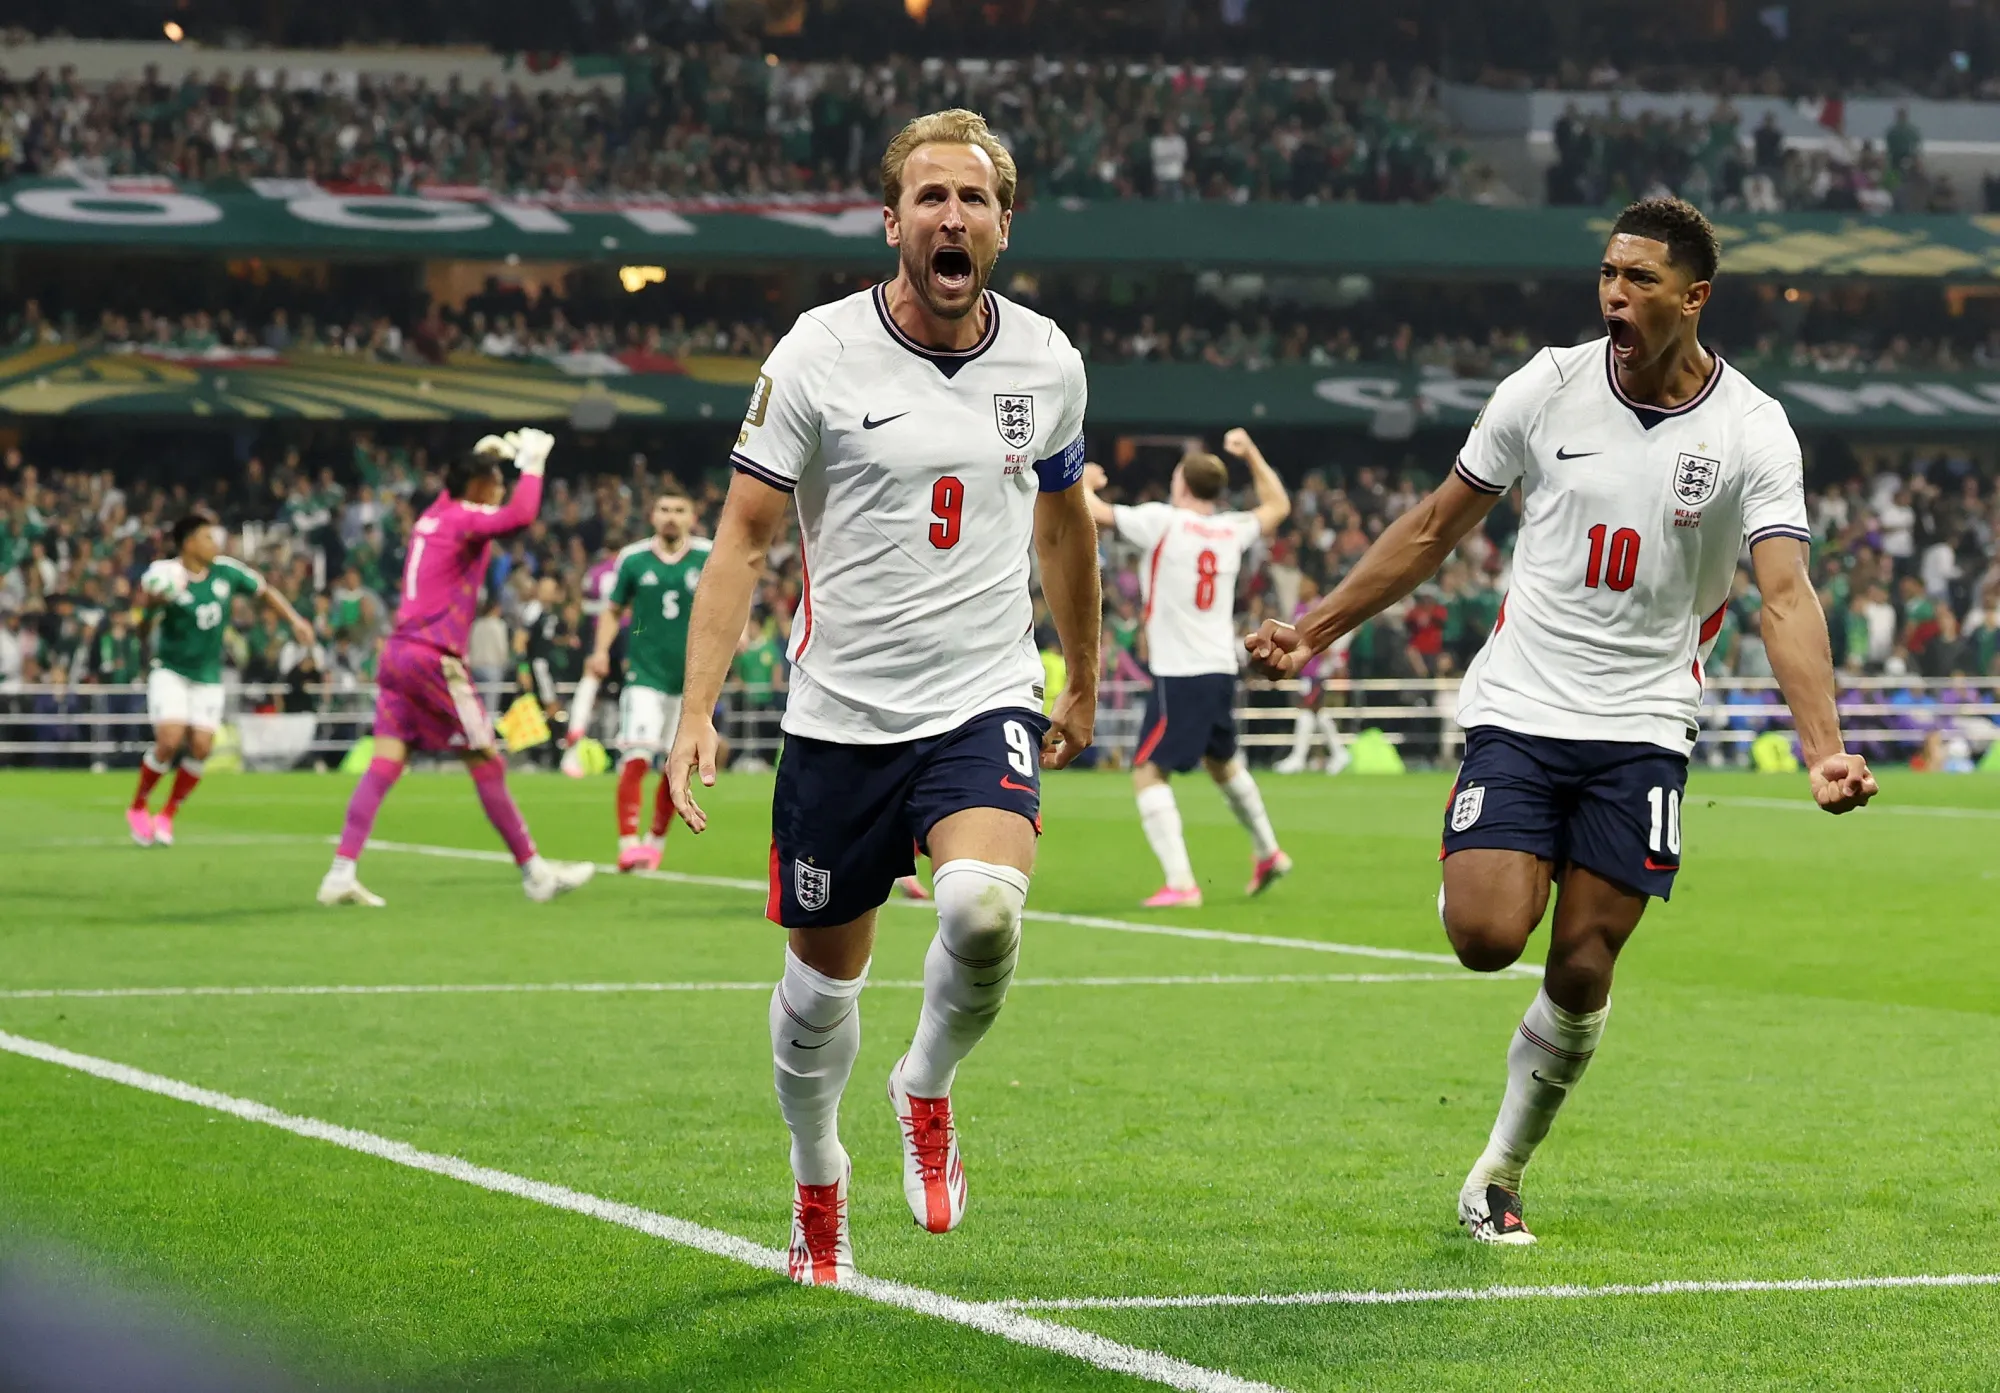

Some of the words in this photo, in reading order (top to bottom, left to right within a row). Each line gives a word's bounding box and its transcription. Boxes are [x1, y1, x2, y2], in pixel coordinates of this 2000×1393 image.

[1005, 454, 1028, 464] MEXICO
[928, 475, 965, 550] 9
[1674, 508, 1702, 519] MEXICO
[1195, 549, 1217, 611] 8
[1584, 523, 1641, 592] 10
[1003, 719, 1034, 778] 9
[1647, 786, 1680, 855] 10
